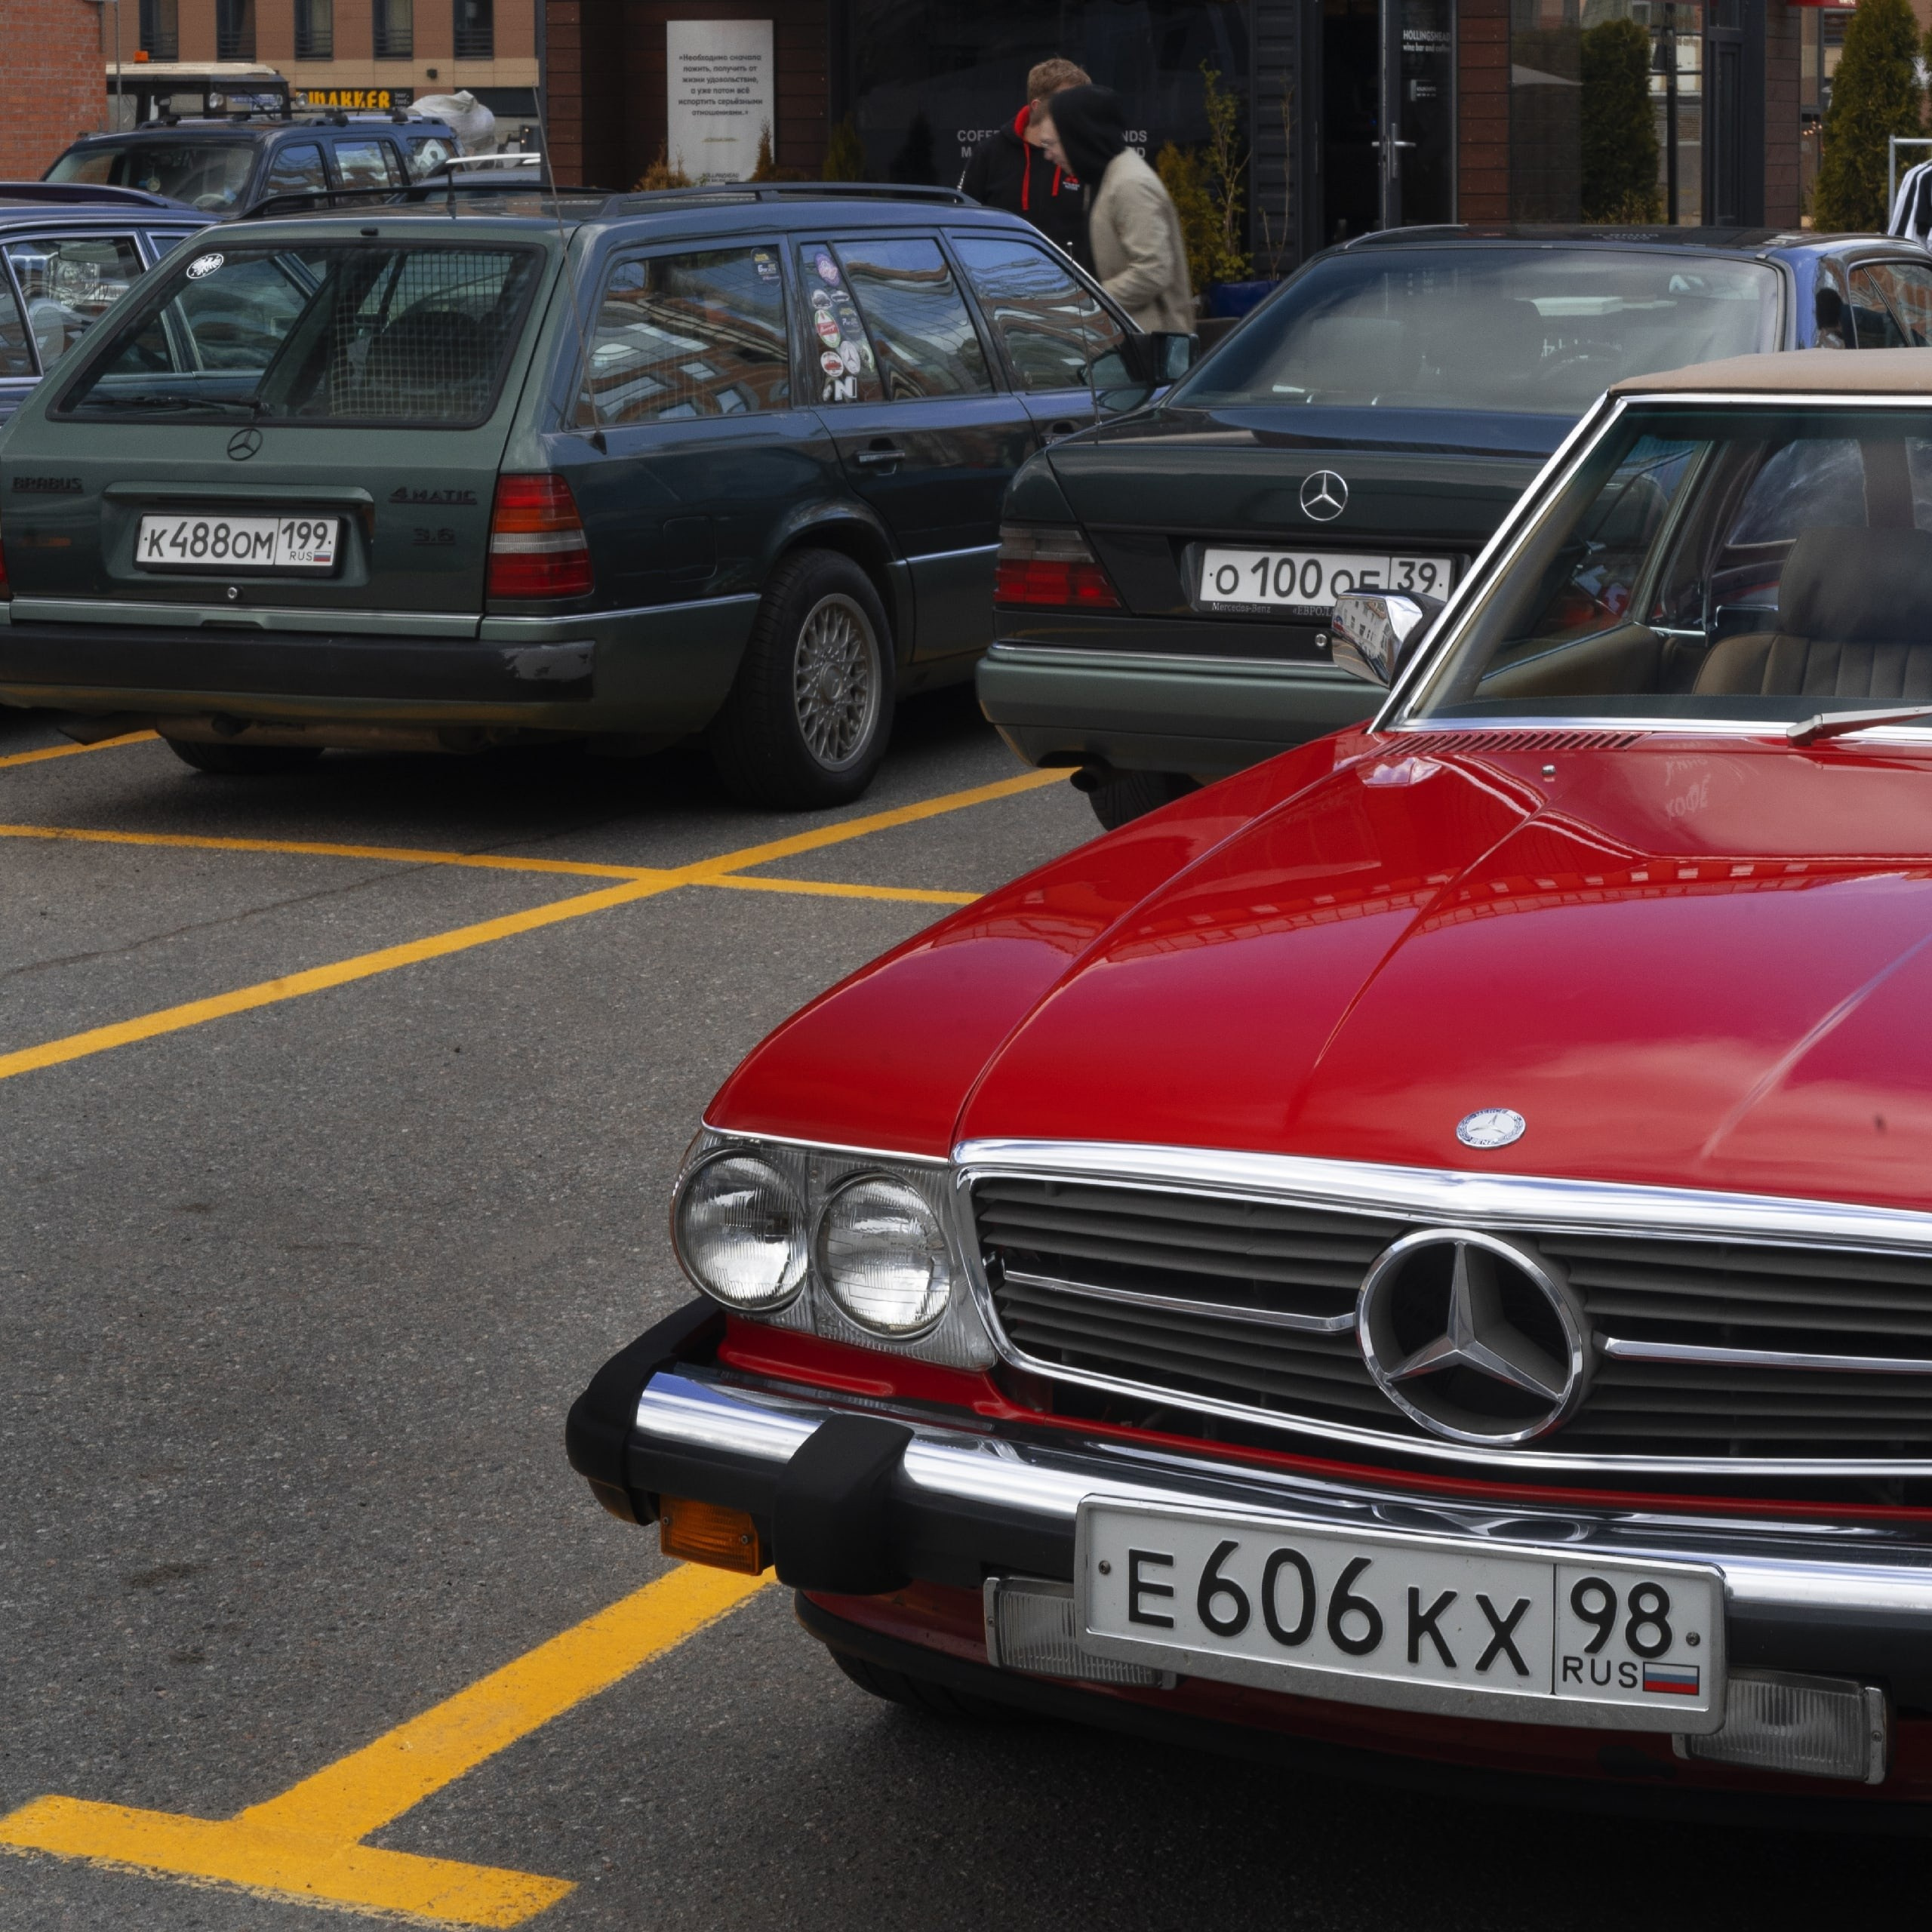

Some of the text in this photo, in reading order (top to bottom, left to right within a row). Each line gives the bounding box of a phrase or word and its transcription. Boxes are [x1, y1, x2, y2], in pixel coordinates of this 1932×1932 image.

[13, 477, 82, 492] BRABUS
[281, 521, 328, 549] 199
[289, 551, 312, 561] RUS
[1397, 561, 1437, 593] 39
[1212, 602, 1271, 614] Mercedes-Benz
[1128, 1539, 1673, 1677] Е606КХ 98
[1562, 1656, 1638, 1689] RUS
